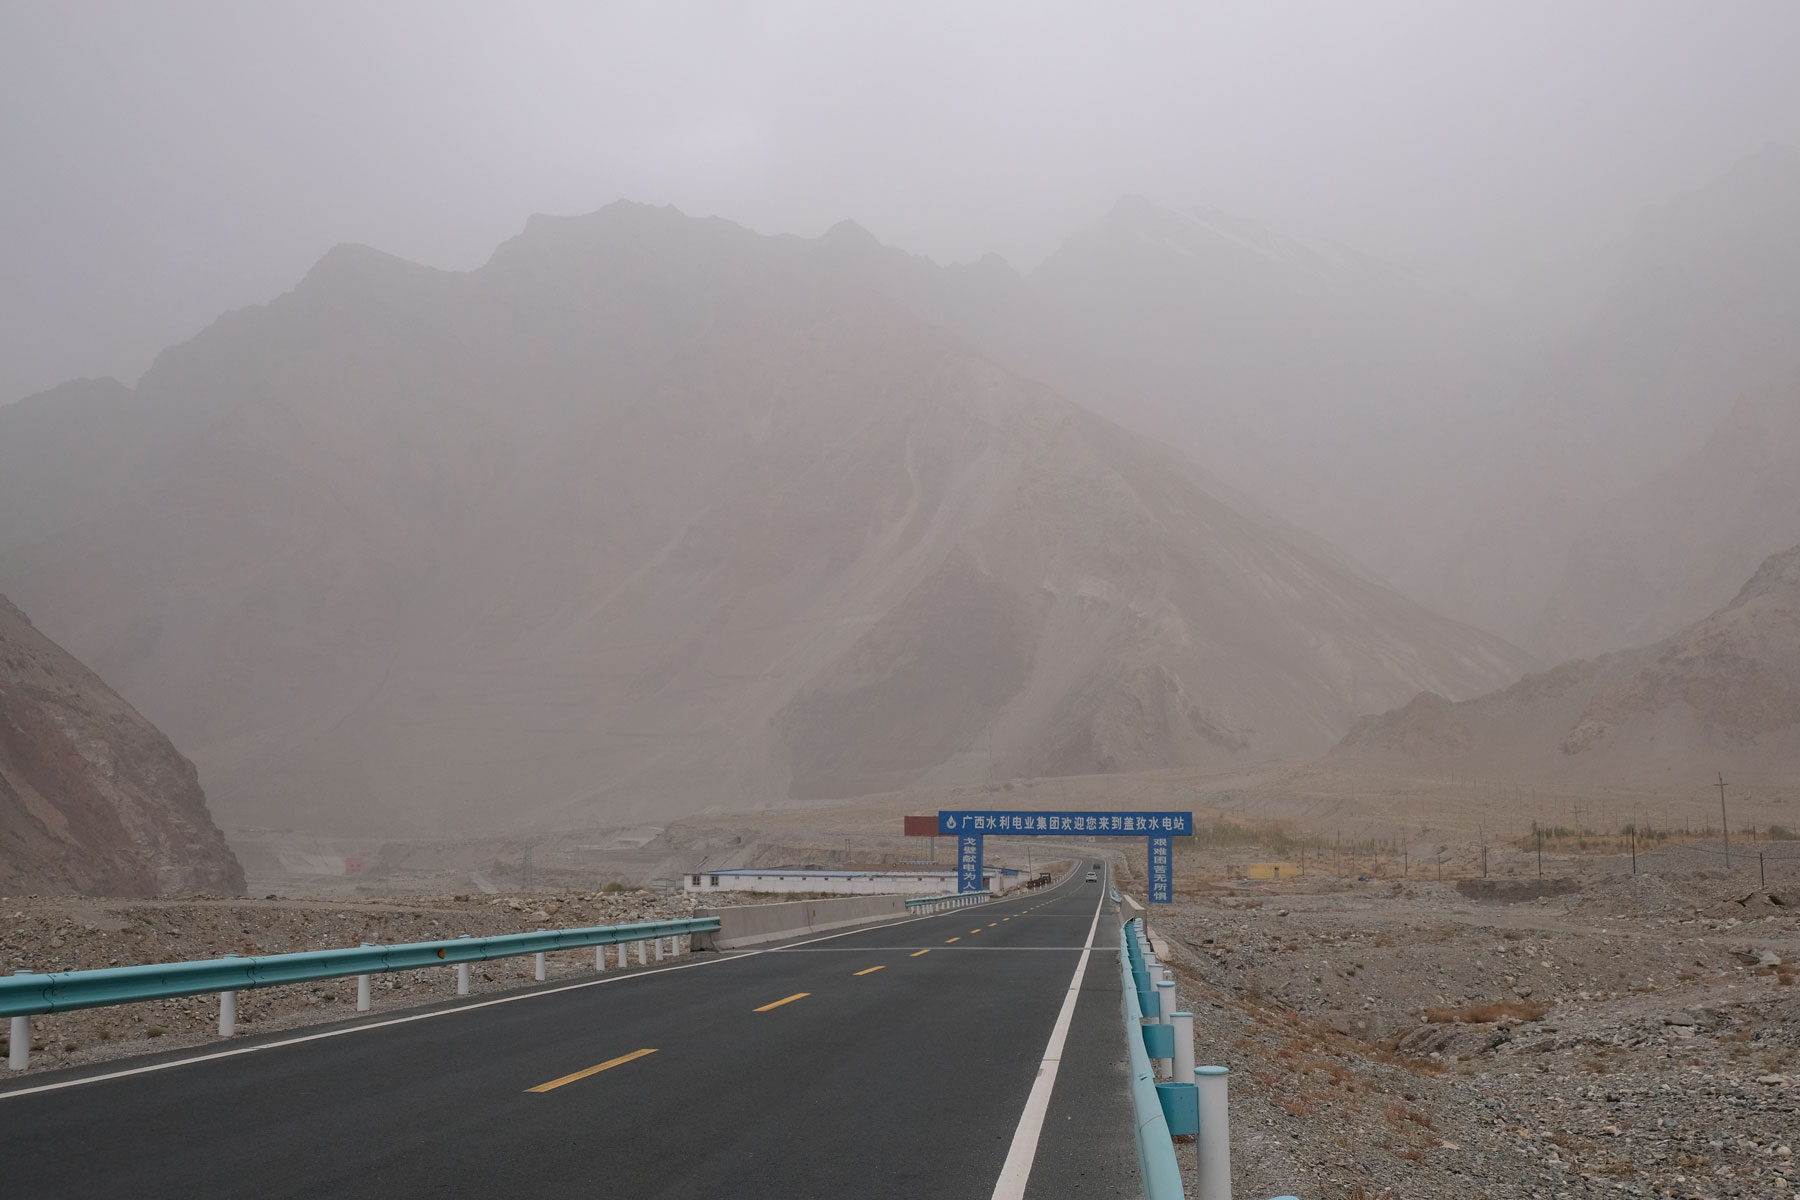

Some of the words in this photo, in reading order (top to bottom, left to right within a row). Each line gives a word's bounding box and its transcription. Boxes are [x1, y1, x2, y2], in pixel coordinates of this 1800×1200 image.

[962, 815, 1184, 831] 广西水利电业集团欢迎您来到盖孜水电站
[1153, 838, 1168, 900] 艰难困苦无所惧
